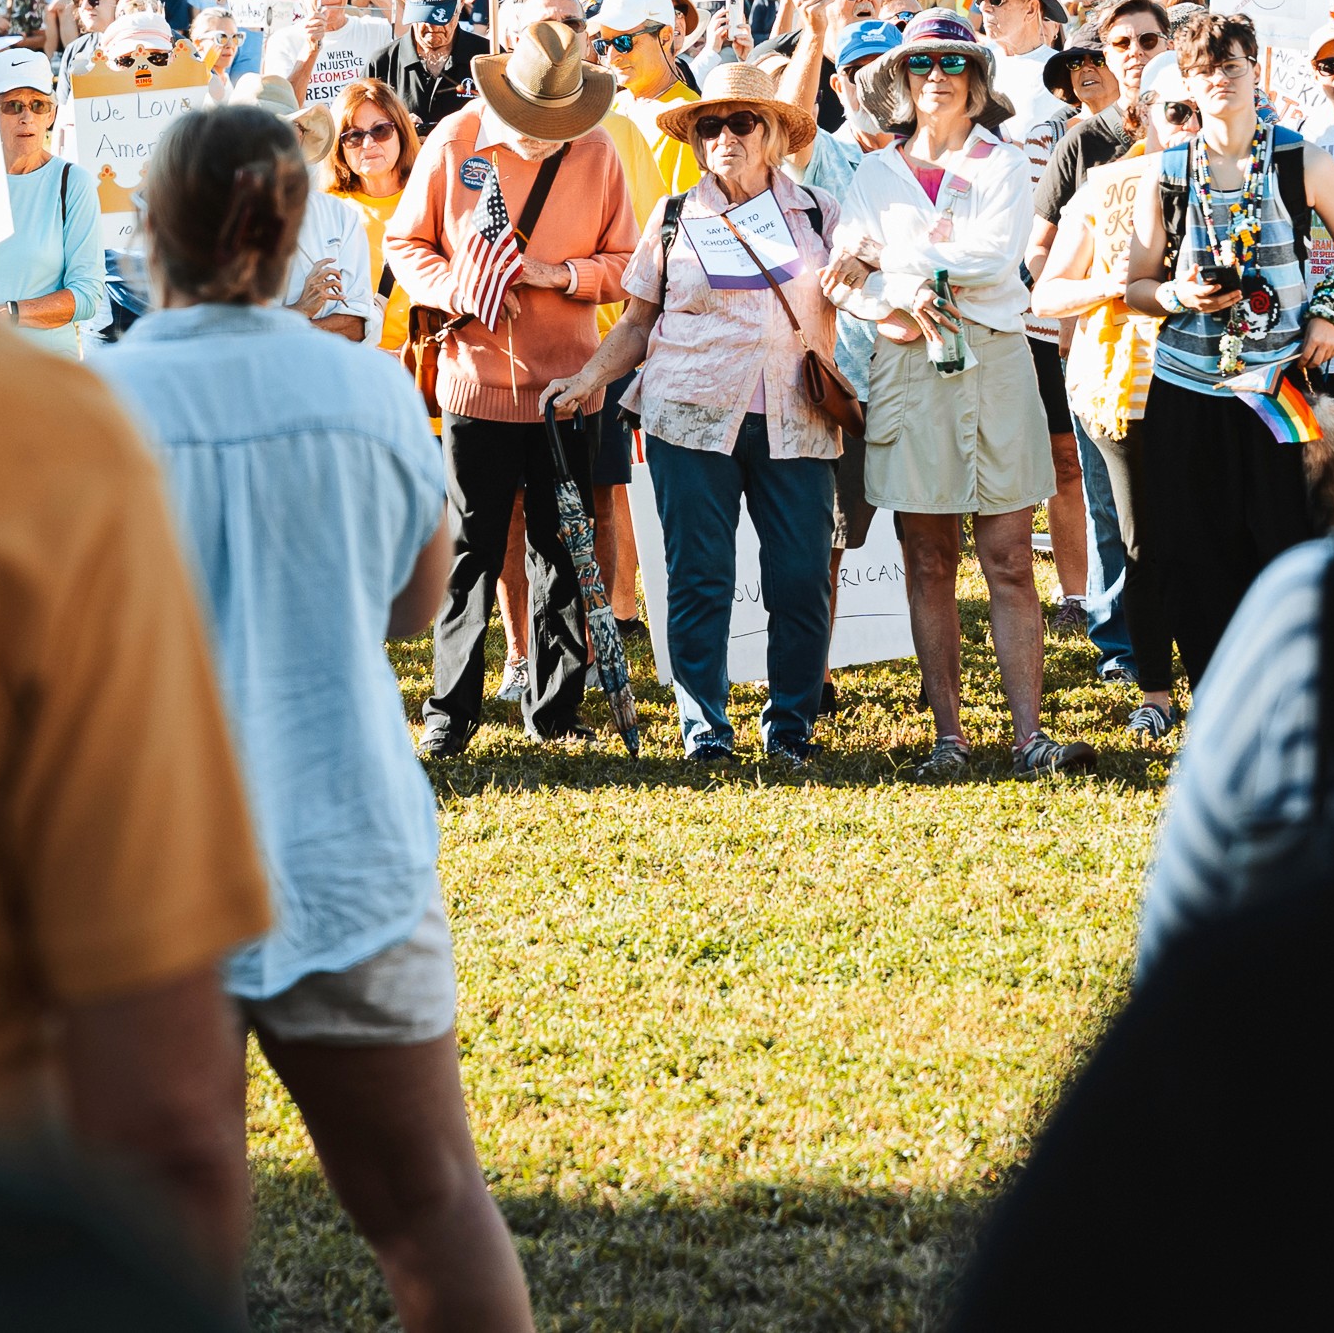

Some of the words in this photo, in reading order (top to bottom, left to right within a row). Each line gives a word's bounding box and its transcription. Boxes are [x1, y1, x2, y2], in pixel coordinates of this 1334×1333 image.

[316, 57, 365, 71] INJUSTICE
[327, 50, 354, 60] WHEN
[1276, 50, 1295, 66] NO
[1273, 67, 1295, 90] NO
[1298, 83, 1326, 106] KI
[90, 98, 125, 122] We
[137, 93, 191, 119] Love
[1104, 175, 1142, 208] No
[706, 227, 721, 235] SAY
[748, 213, 759, 223] TO
[1104, 205, 1134, 236] Ki
[701, 236, 739, 246] SCHOOLS
[753, 221, 775, 234] HOPE
